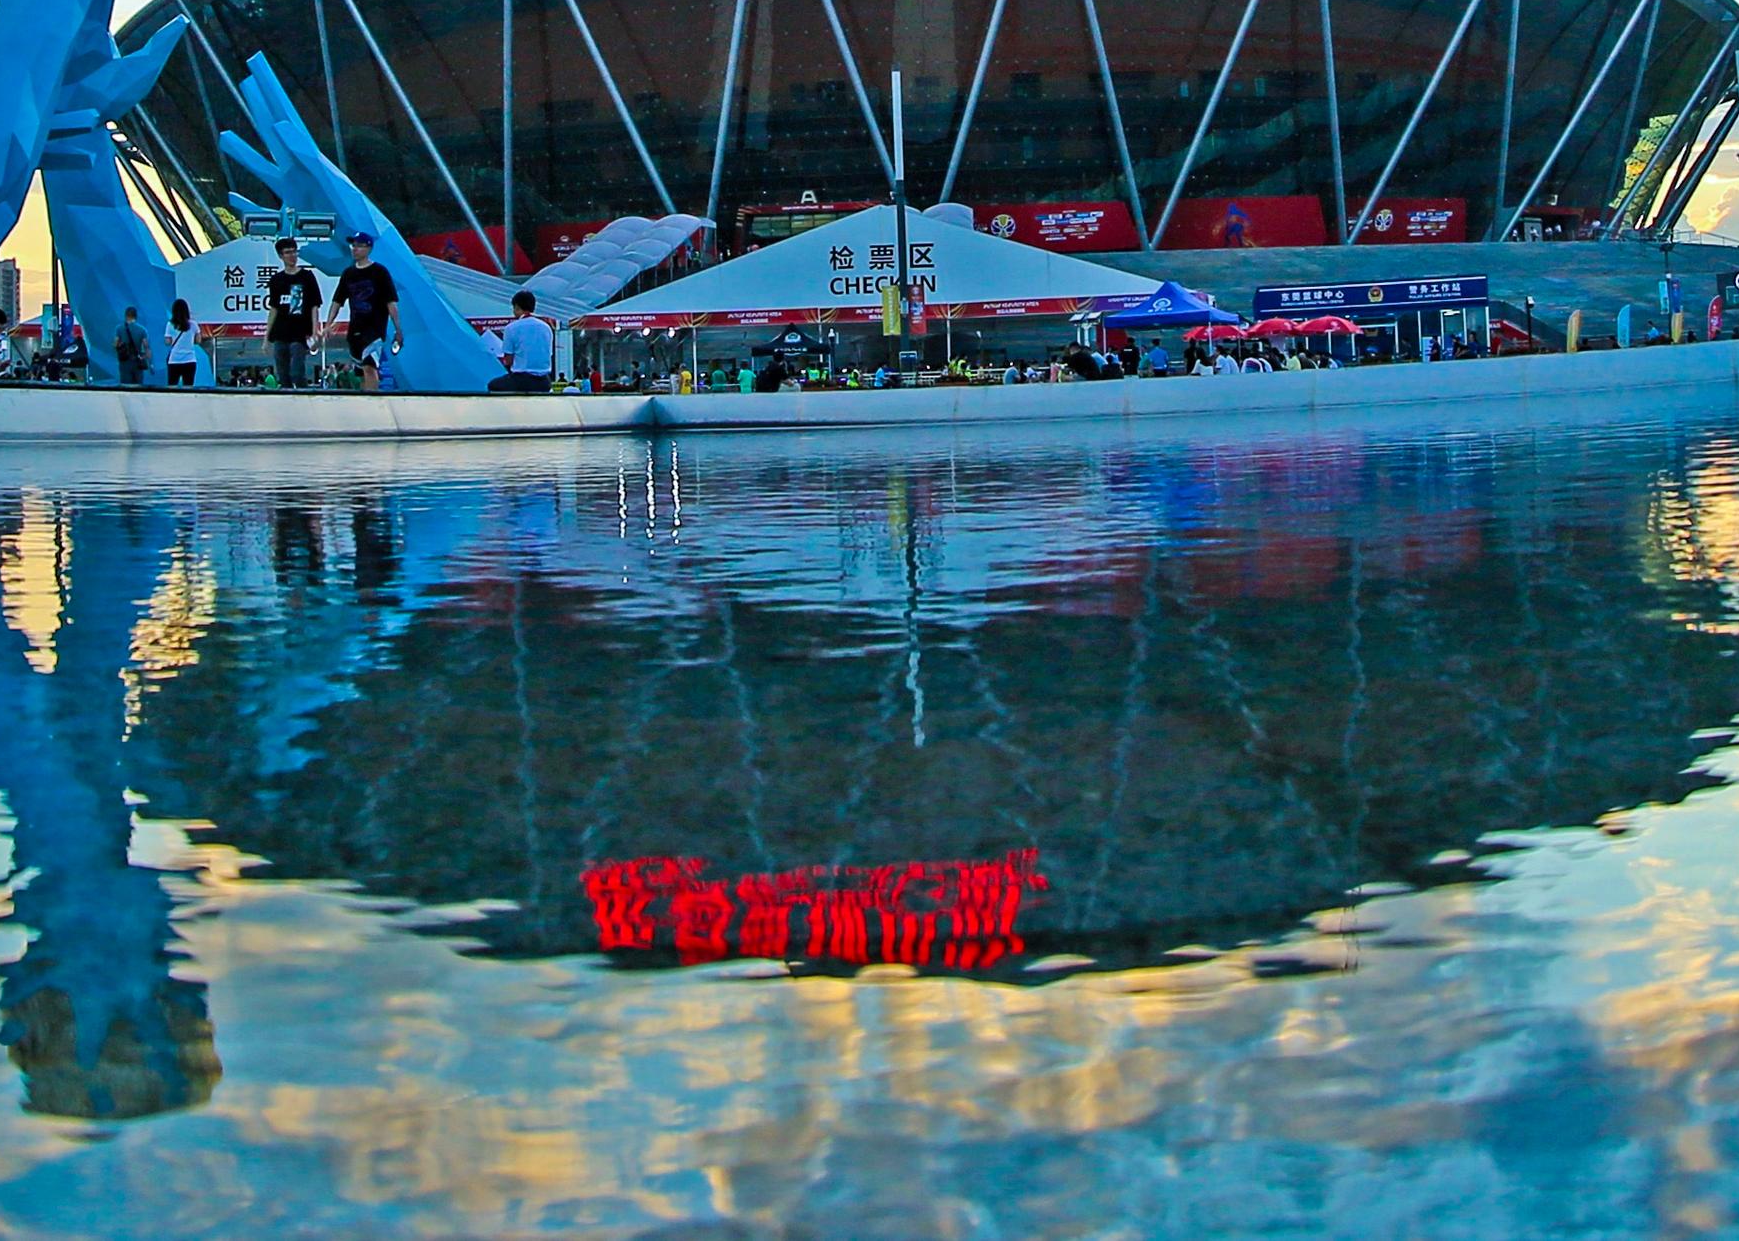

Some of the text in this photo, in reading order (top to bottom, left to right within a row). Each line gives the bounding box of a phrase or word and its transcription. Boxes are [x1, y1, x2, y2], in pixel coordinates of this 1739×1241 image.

[801, 190, 818, 204] A
[829, 243, 936, 271] 检票区
